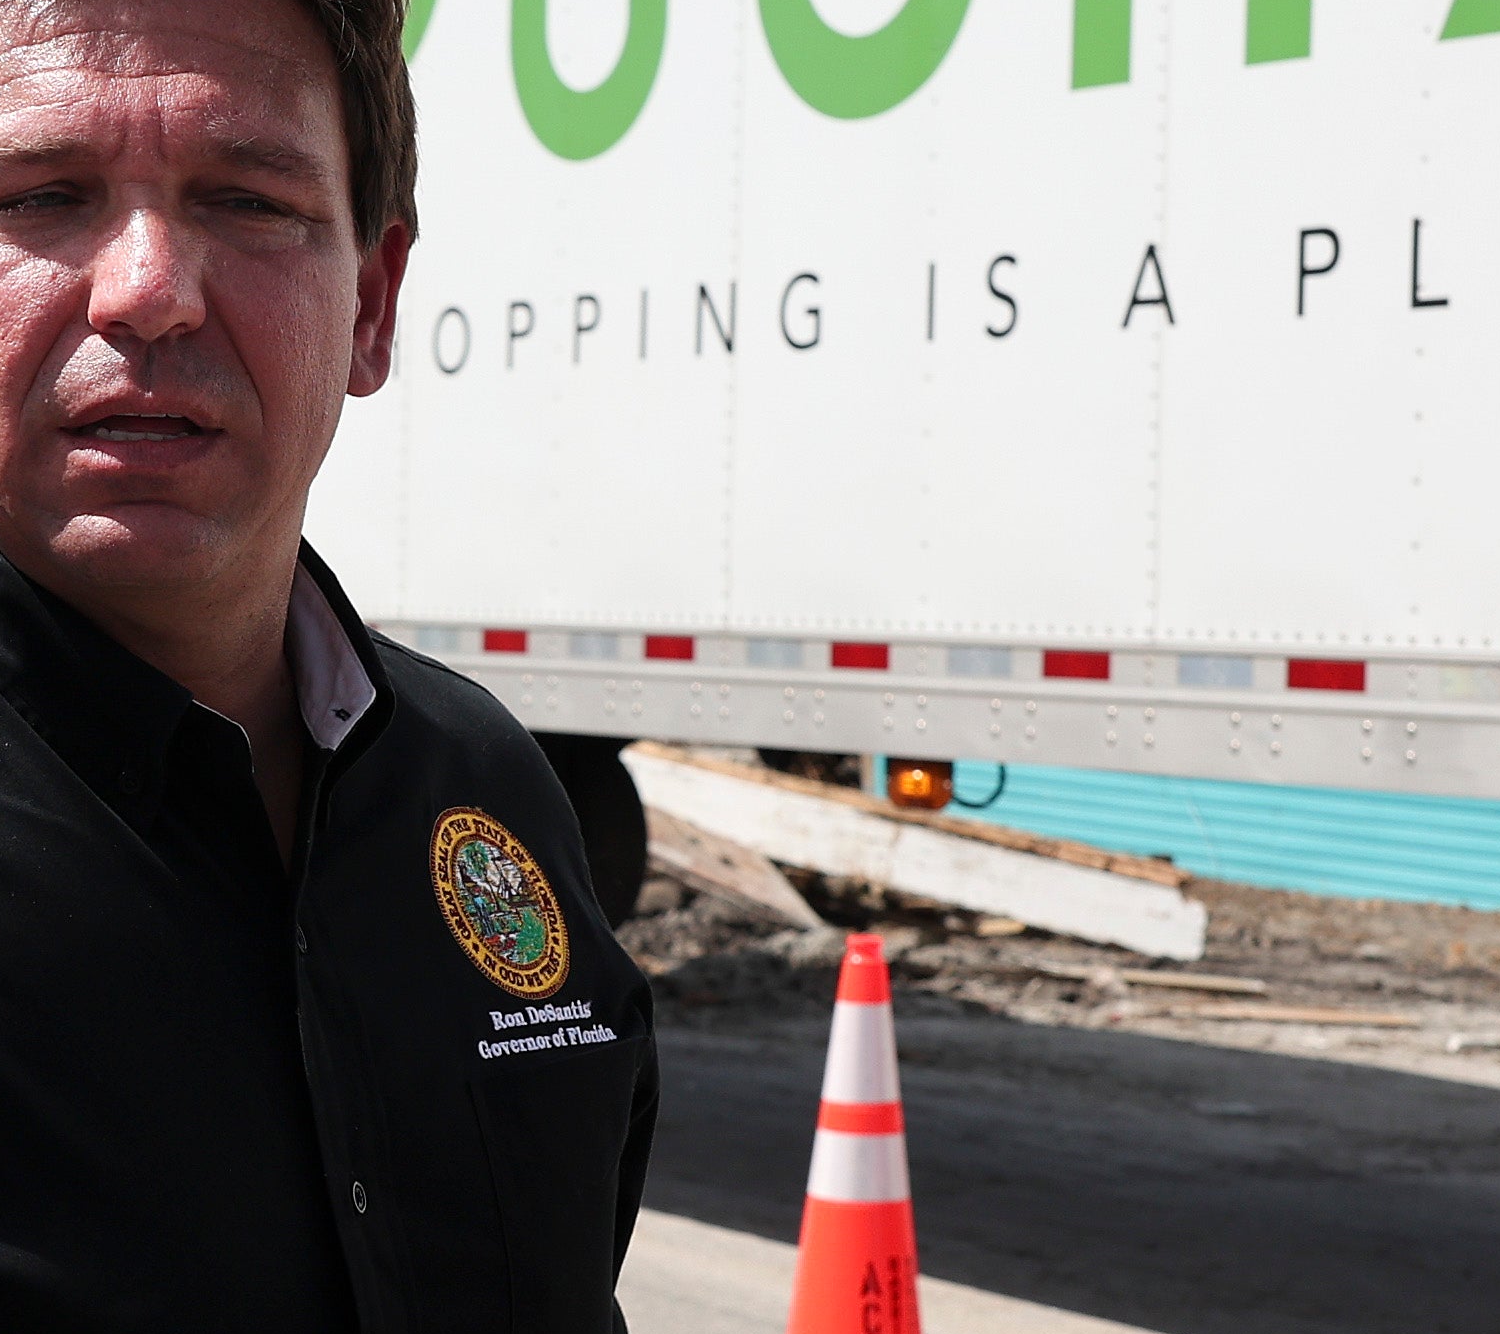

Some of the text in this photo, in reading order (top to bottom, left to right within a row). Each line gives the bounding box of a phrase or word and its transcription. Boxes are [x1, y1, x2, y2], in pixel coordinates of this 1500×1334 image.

[392, 271, 825, 377] OPPING
[926, 252, 1020, 342] IS
[1119, 242, 1178, 330] A
[436, 846, 449, 884] SEAL
[489, 1000, 591, 1030] Ron DeSantis
[478, 1024, 617, 1059] Governor of Florida
